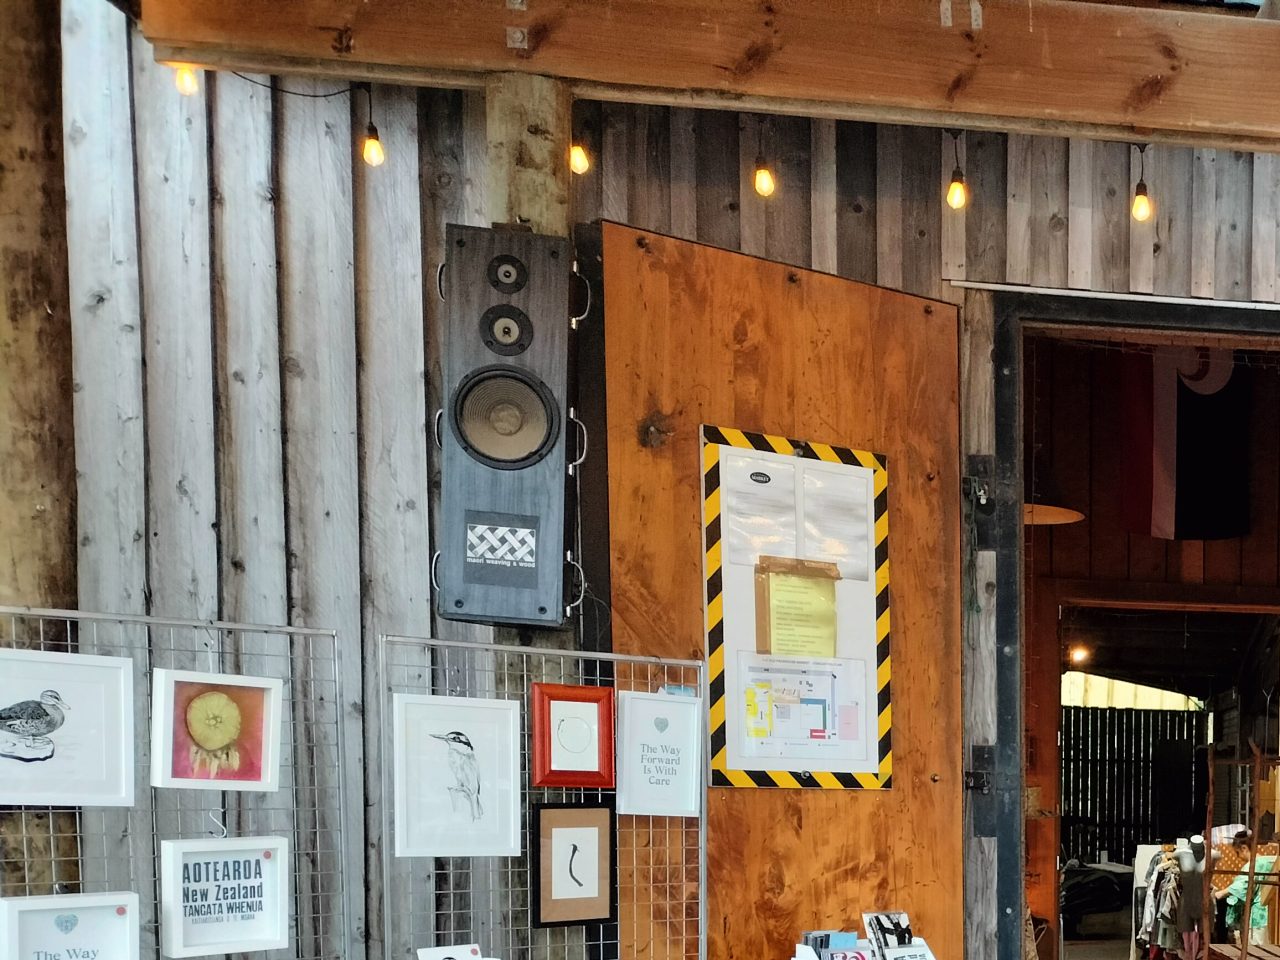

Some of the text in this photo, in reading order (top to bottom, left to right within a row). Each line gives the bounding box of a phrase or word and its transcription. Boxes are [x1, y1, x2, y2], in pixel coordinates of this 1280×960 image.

[640, 743, 681, 756] The Way
[640, 754, 681, 765] Forward
[643, 765, 677, 776] Is With
[648, 775, 671, 786] Care
[182, 859, 262, 884] AOTEAROA
[182, 882, 263, 903] New Zealand
[226, 900, 263, 914] WHENUA
[66, 948, 99, 960] Way
